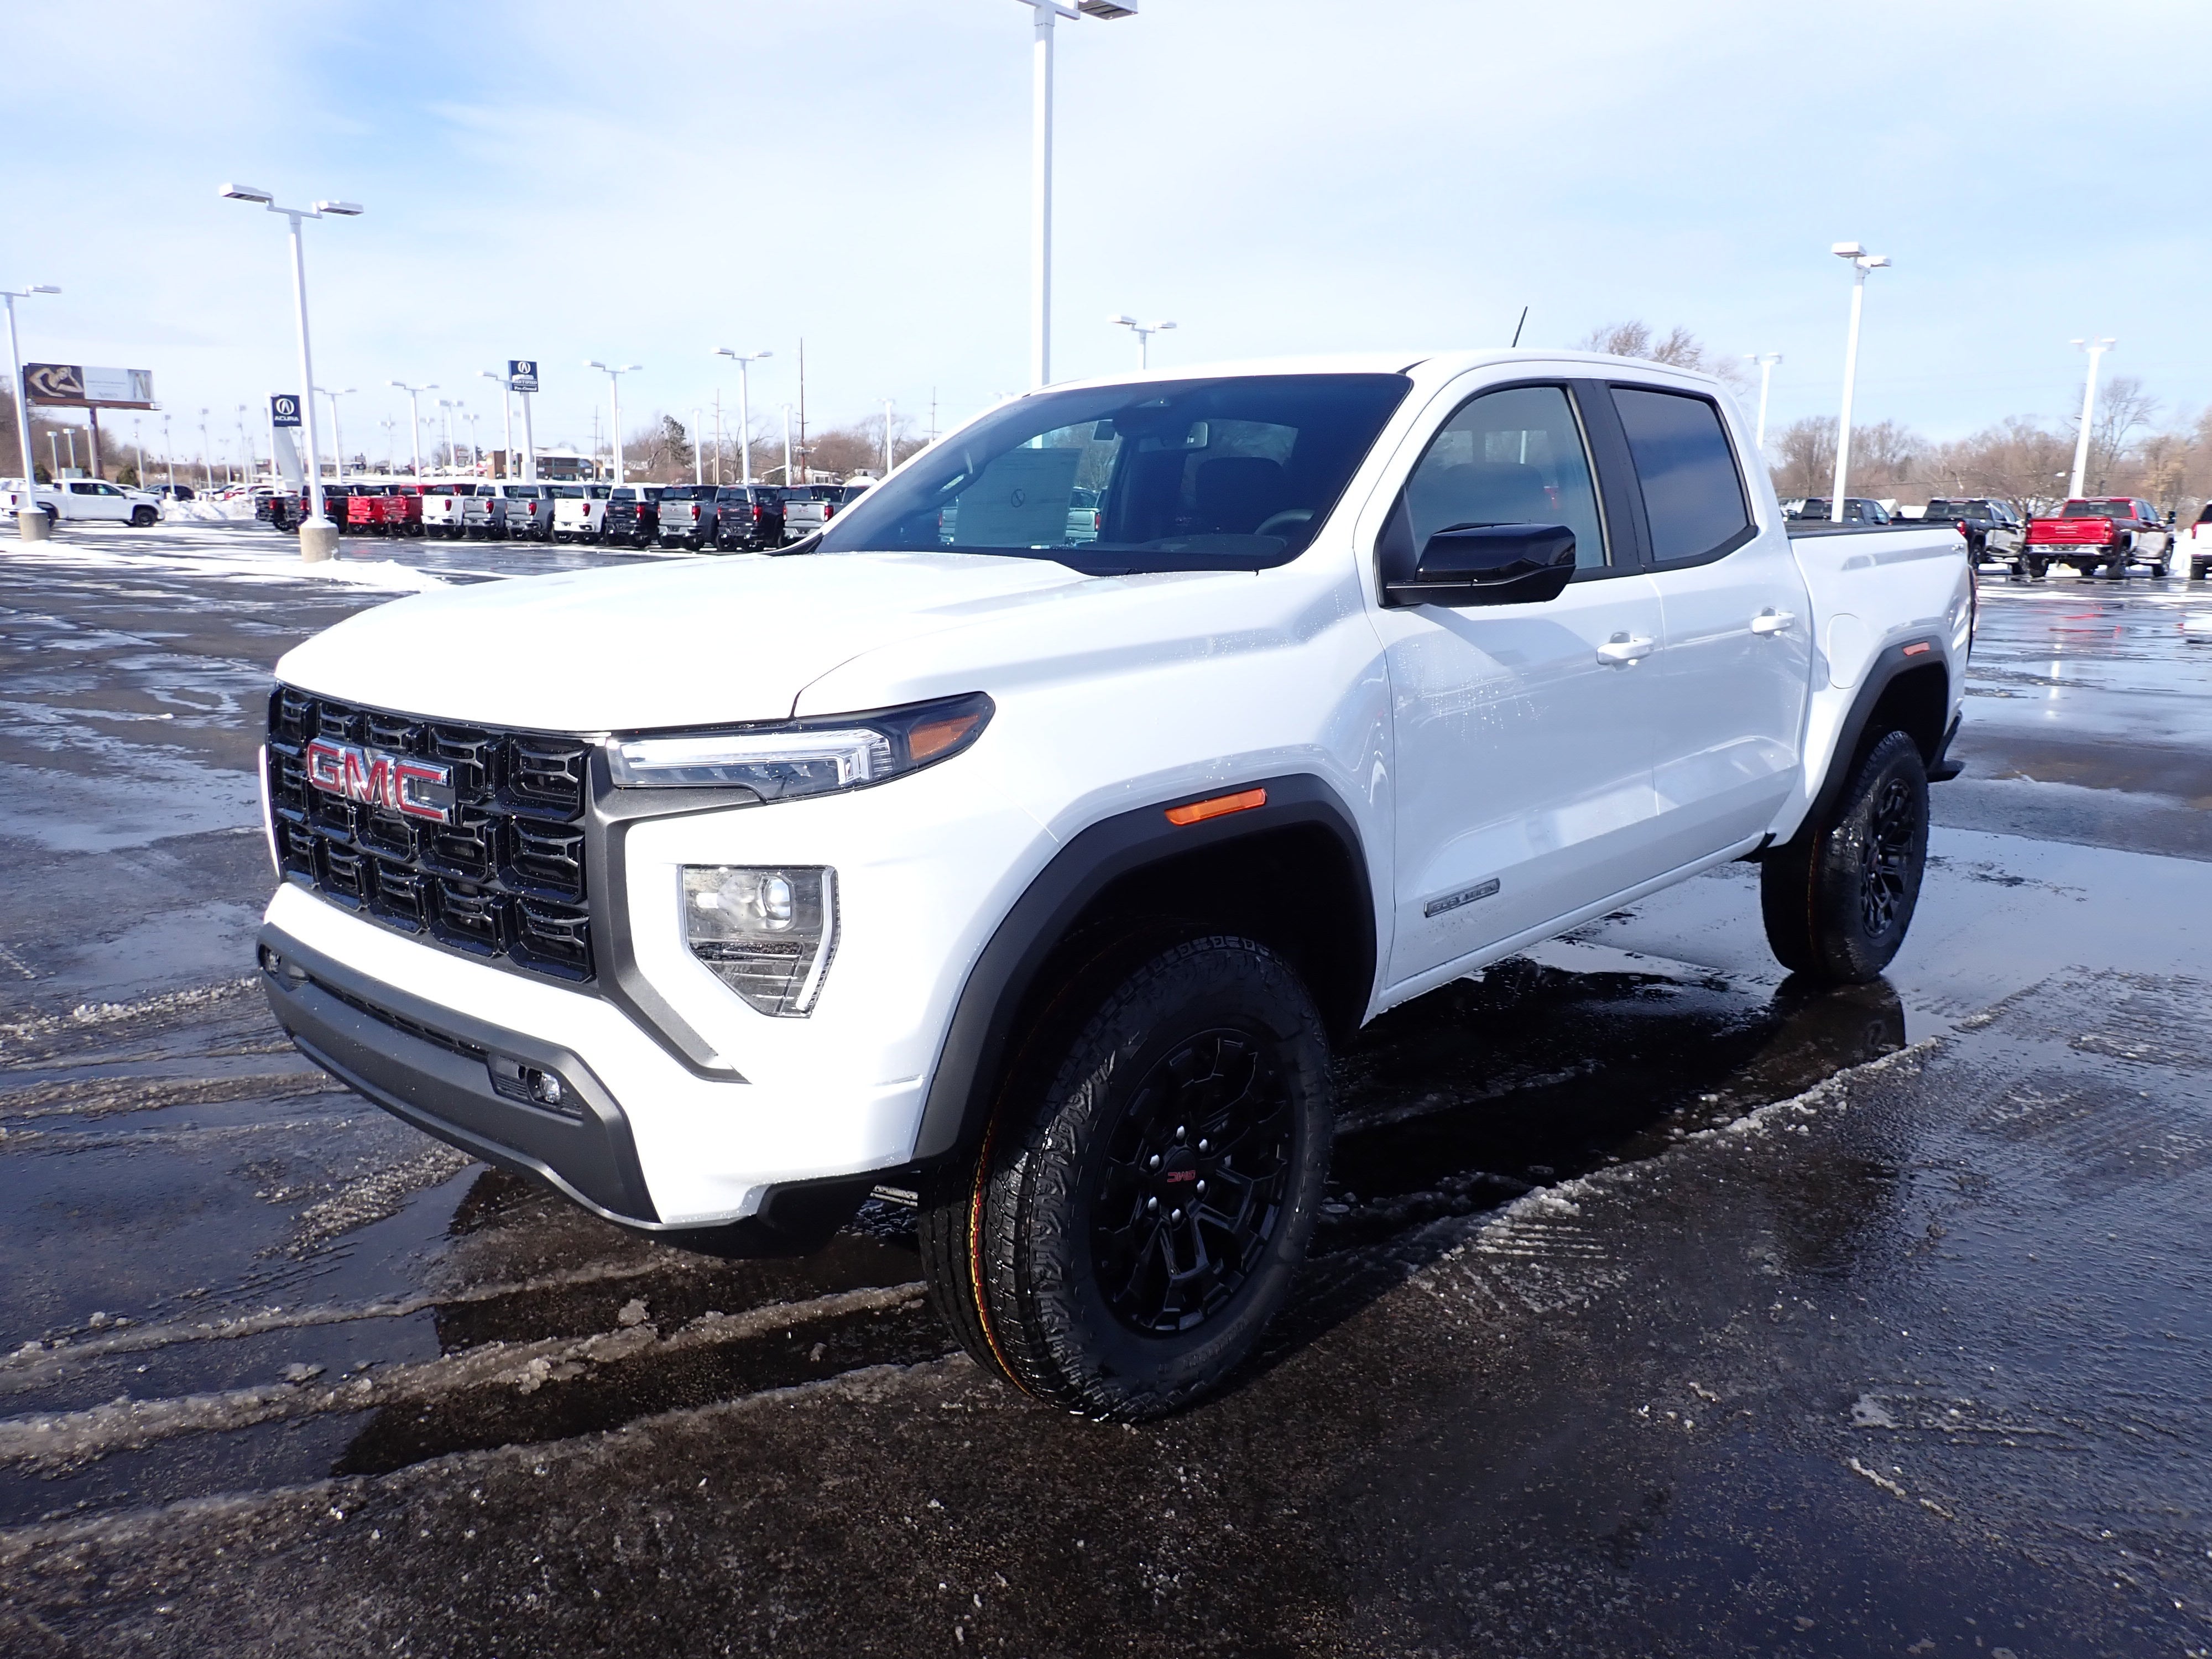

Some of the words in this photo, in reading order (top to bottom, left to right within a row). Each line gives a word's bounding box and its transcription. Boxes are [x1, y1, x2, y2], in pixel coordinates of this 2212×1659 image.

[307, 737, 451, 825] GMC
[1431, 884, 1496, 912] ELEVATION
[1167, 1170, 1196, 1182] GMC
